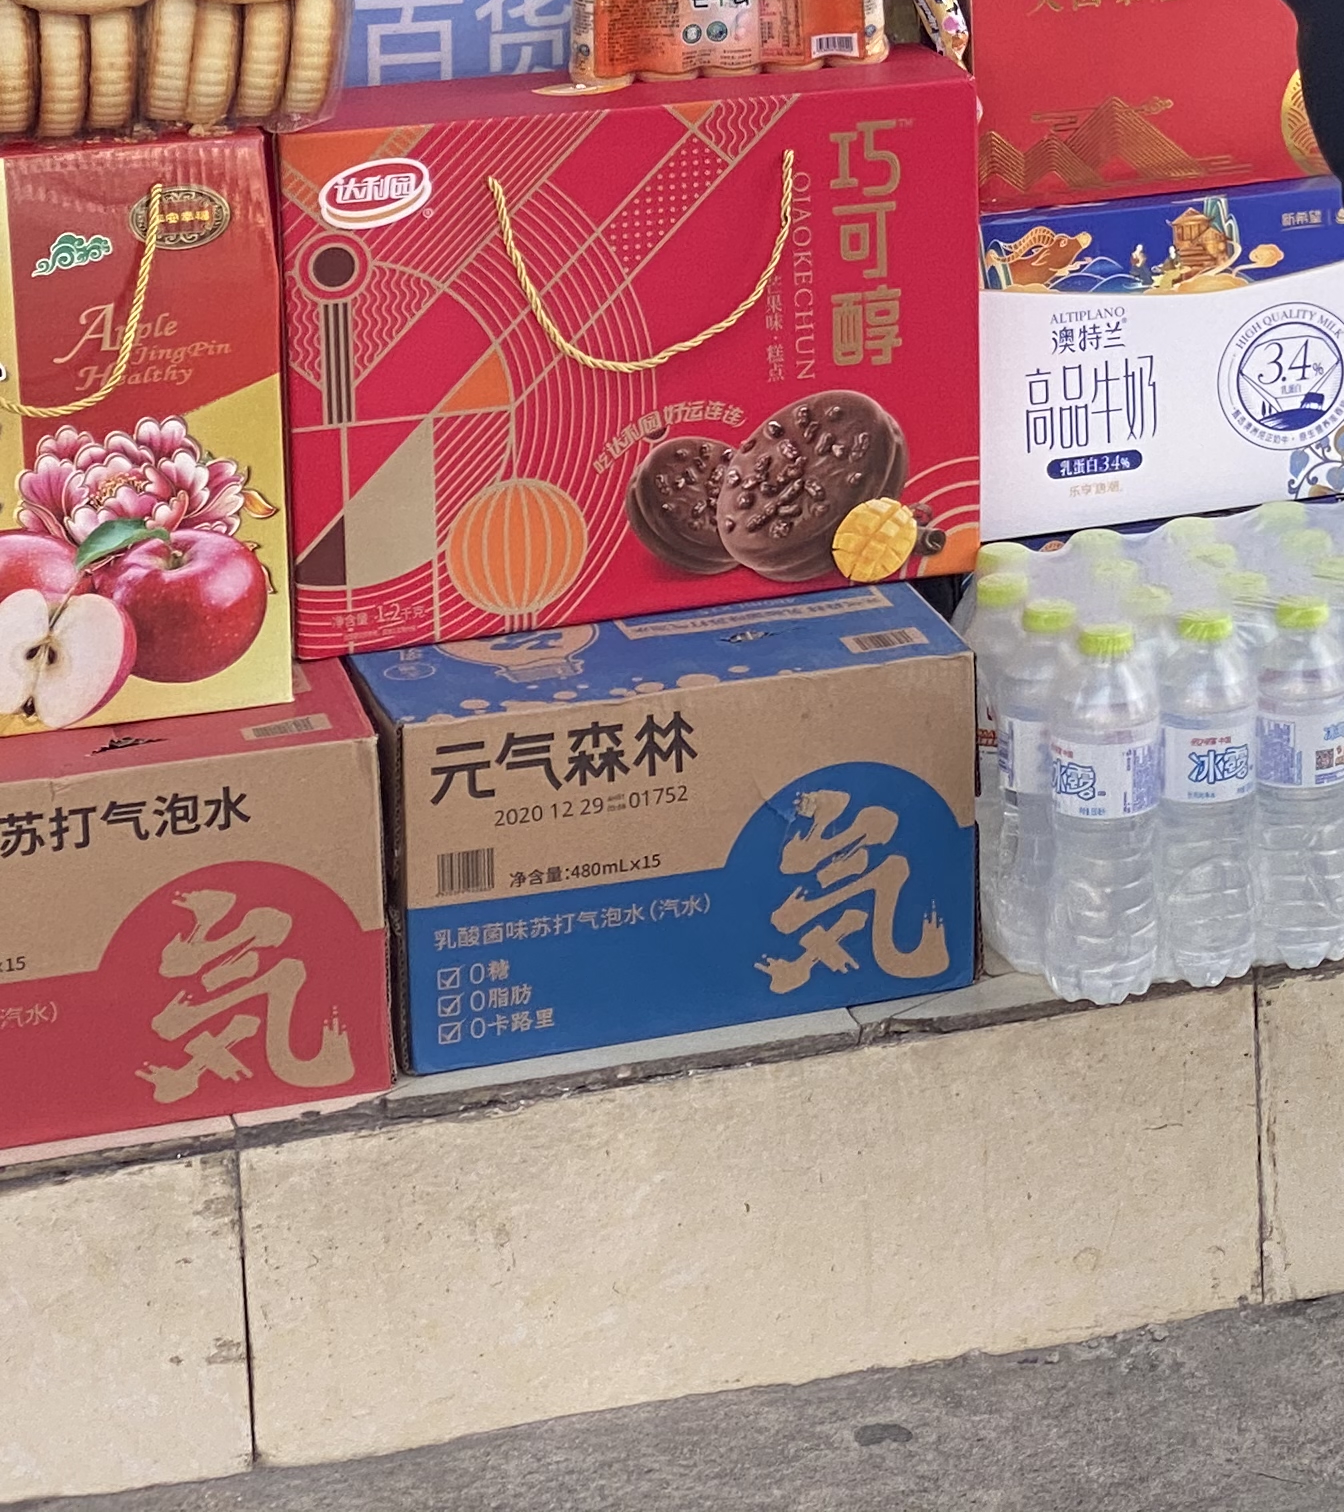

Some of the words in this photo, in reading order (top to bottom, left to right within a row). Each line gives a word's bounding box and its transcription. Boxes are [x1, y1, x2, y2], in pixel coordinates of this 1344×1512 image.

[332, 173, 417, 205] 达利园
[1050, 306, 1125, 325] ALTIPLANO
[1262, 309, 1317, 327] QUALITY
[1051, 322, 1126, 355] 澳特兰
[1257, 339, 1325, 385] 3.4%
[1025, 355, 1157, 454] 高品牛奶
[430, 711, 697, 805] 元气森林
[0, 786, 251, 859] 苏打气泡水
[494, 805, 543, 827] 2020
[550, 801, 574, 819] 12
[580, 797, 604, 816] 29
[628, 785, 689, 809] 01752
